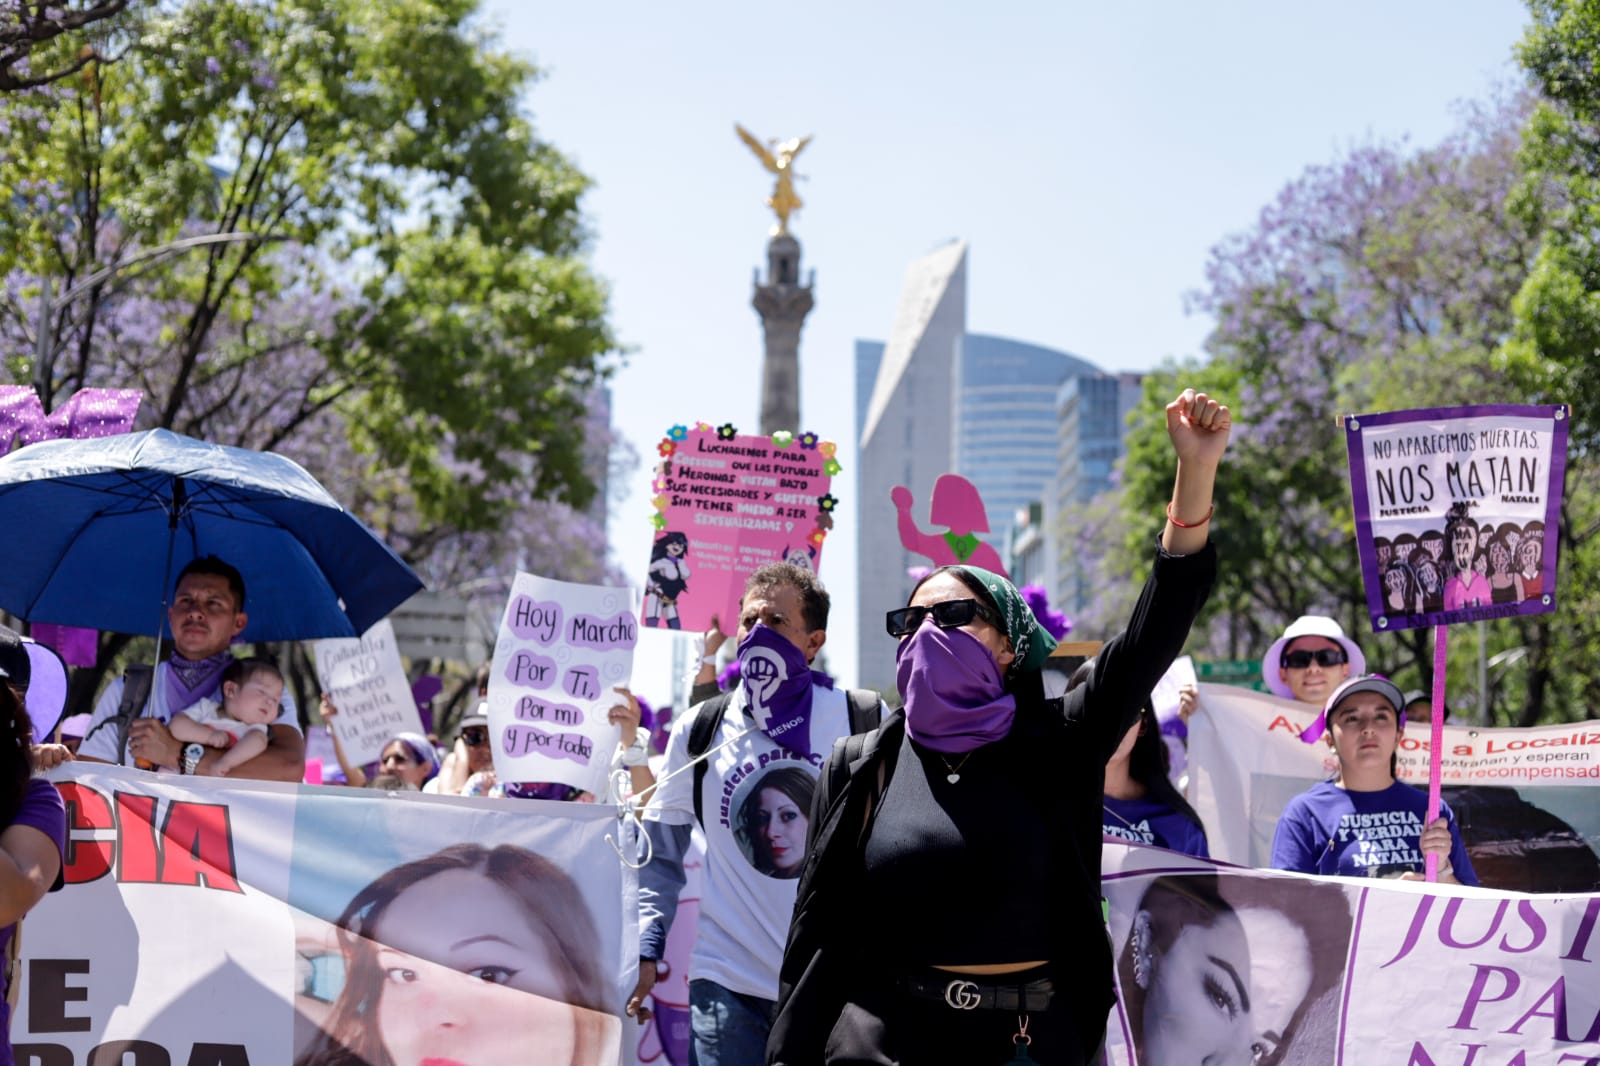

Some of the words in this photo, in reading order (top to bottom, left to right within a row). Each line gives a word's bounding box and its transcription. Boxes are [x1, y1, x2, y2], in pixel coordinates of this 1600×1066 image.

[1373, 439, 1391, 460] NO
[1398, 432, 1476, 457] APARECEMOS
[754, 463, 771, 473] LAS
[1376, 464, 1434, 506] NOS
[1446, 456, 1537, 498] MATAN
[695, 499, 733, 513] TENER
[776, 507, 785, 516] A
[786, 508, 807, 519] SER
[1379, 506, 1430, 518] JUSTICIA
[514, 599, 556, 642] Hoy
[514, 654, 550, 681] Por
[520, 697, 544, 718] Por
[768, 716, 804, 738] MENOS
[1452, 744, 1473, 756] a
[1513, 754, 1522, 763] y
[1526, 751, 1590, 763] esperan
[1341, 811, 1420, 828] JUSTICIA
[1338, 828, 1350, 842] Y
[1359, 838, 1409, 853] PARA
[1447, 963, 1600, 1043] PA
